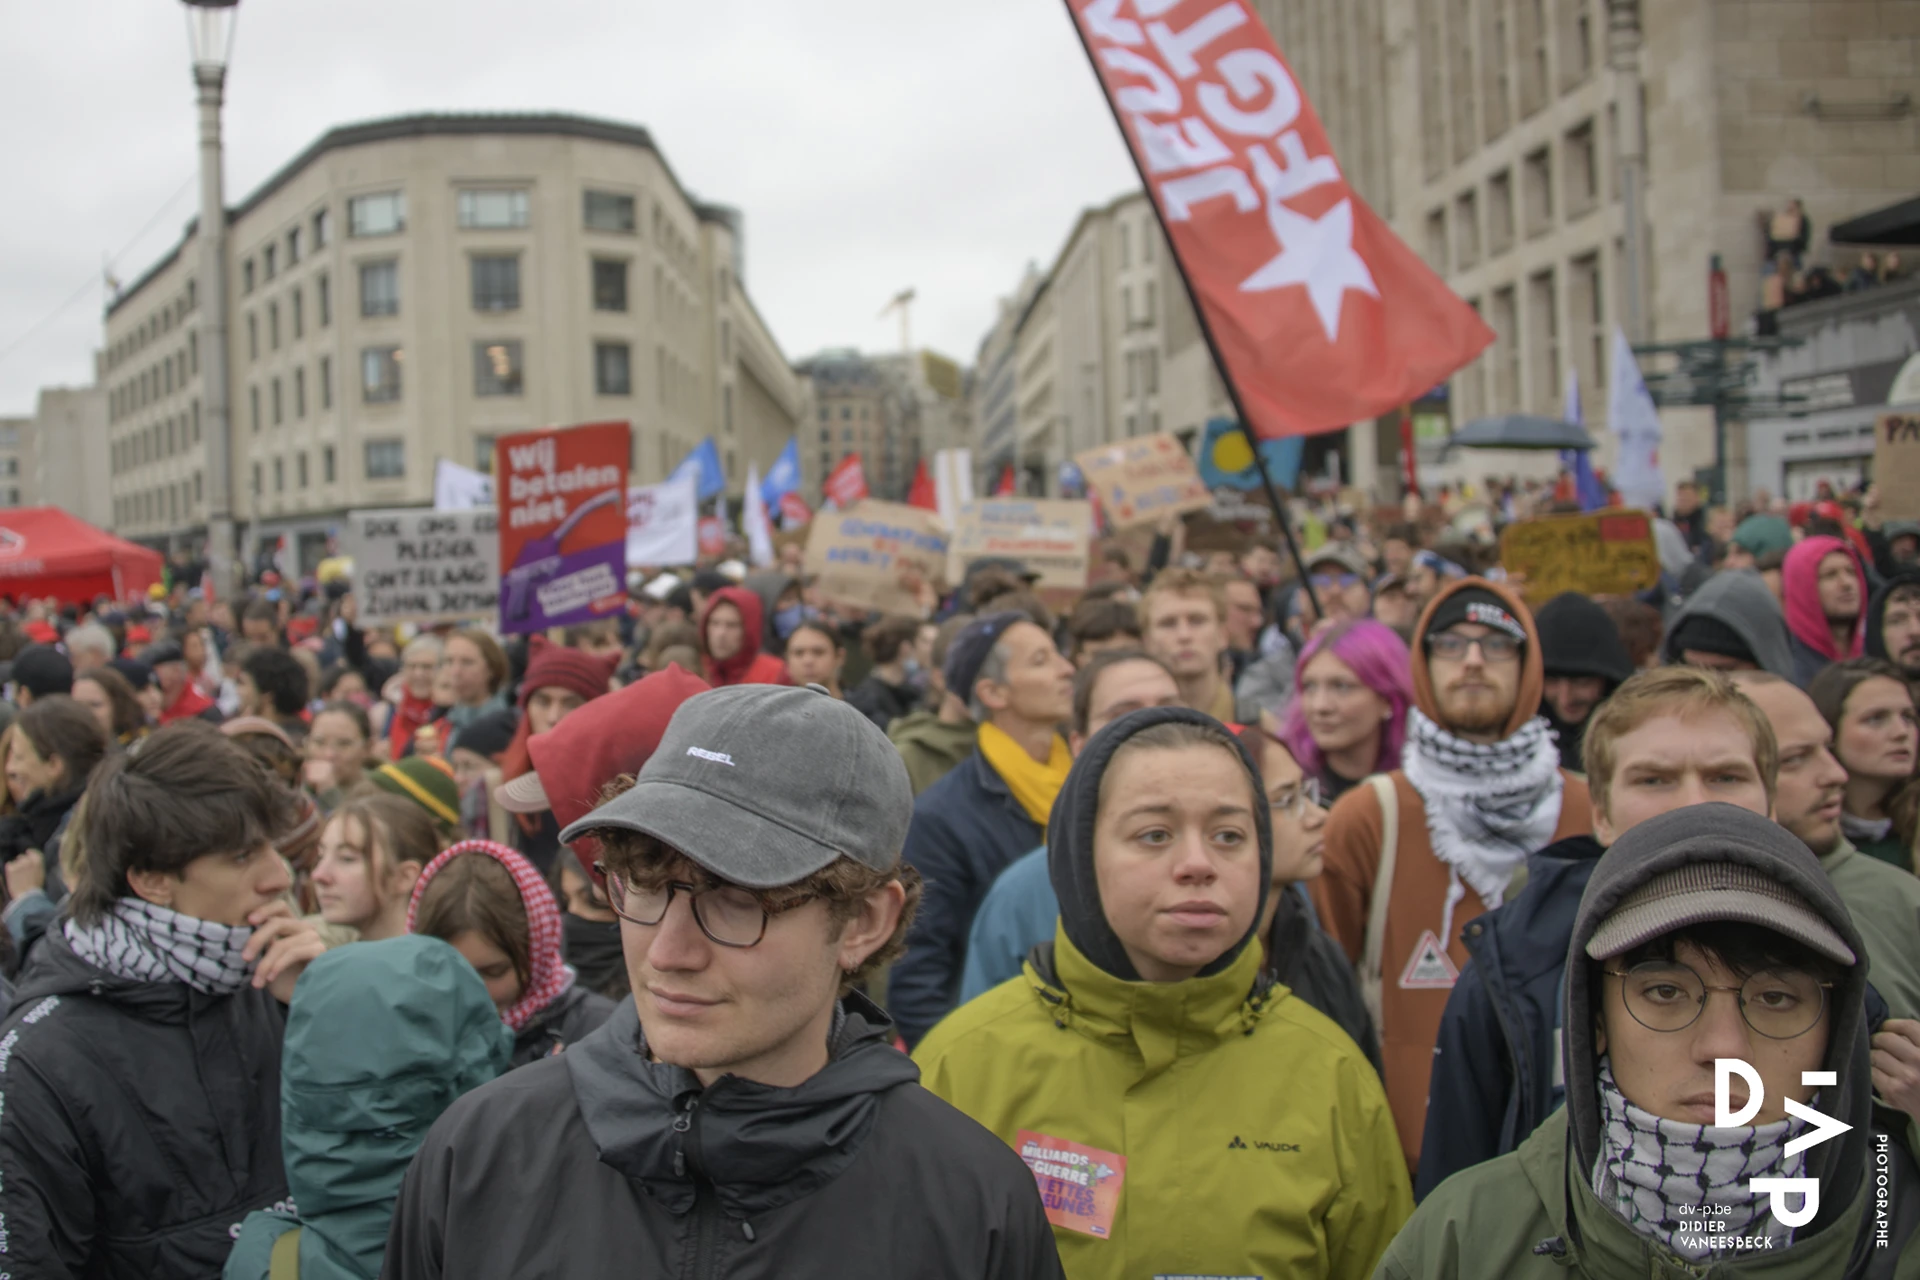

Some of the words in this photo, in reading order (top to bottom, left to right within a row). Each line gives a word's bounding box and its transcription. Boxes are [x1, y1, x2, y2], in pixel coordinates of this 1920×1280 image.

[509, 464, 619, 501] betalen
[509, 496, 565, 527] niet
[686, 746, 735, 767] REBEL
[1022, 1145, 1089, 1166] MILLIARDS
[1253, 1140, 1301, 1153] VAUDE
[1034, 1160, 1089, 1186] GUERRE
[1042, 1192, 1096, 1216] EUNES
